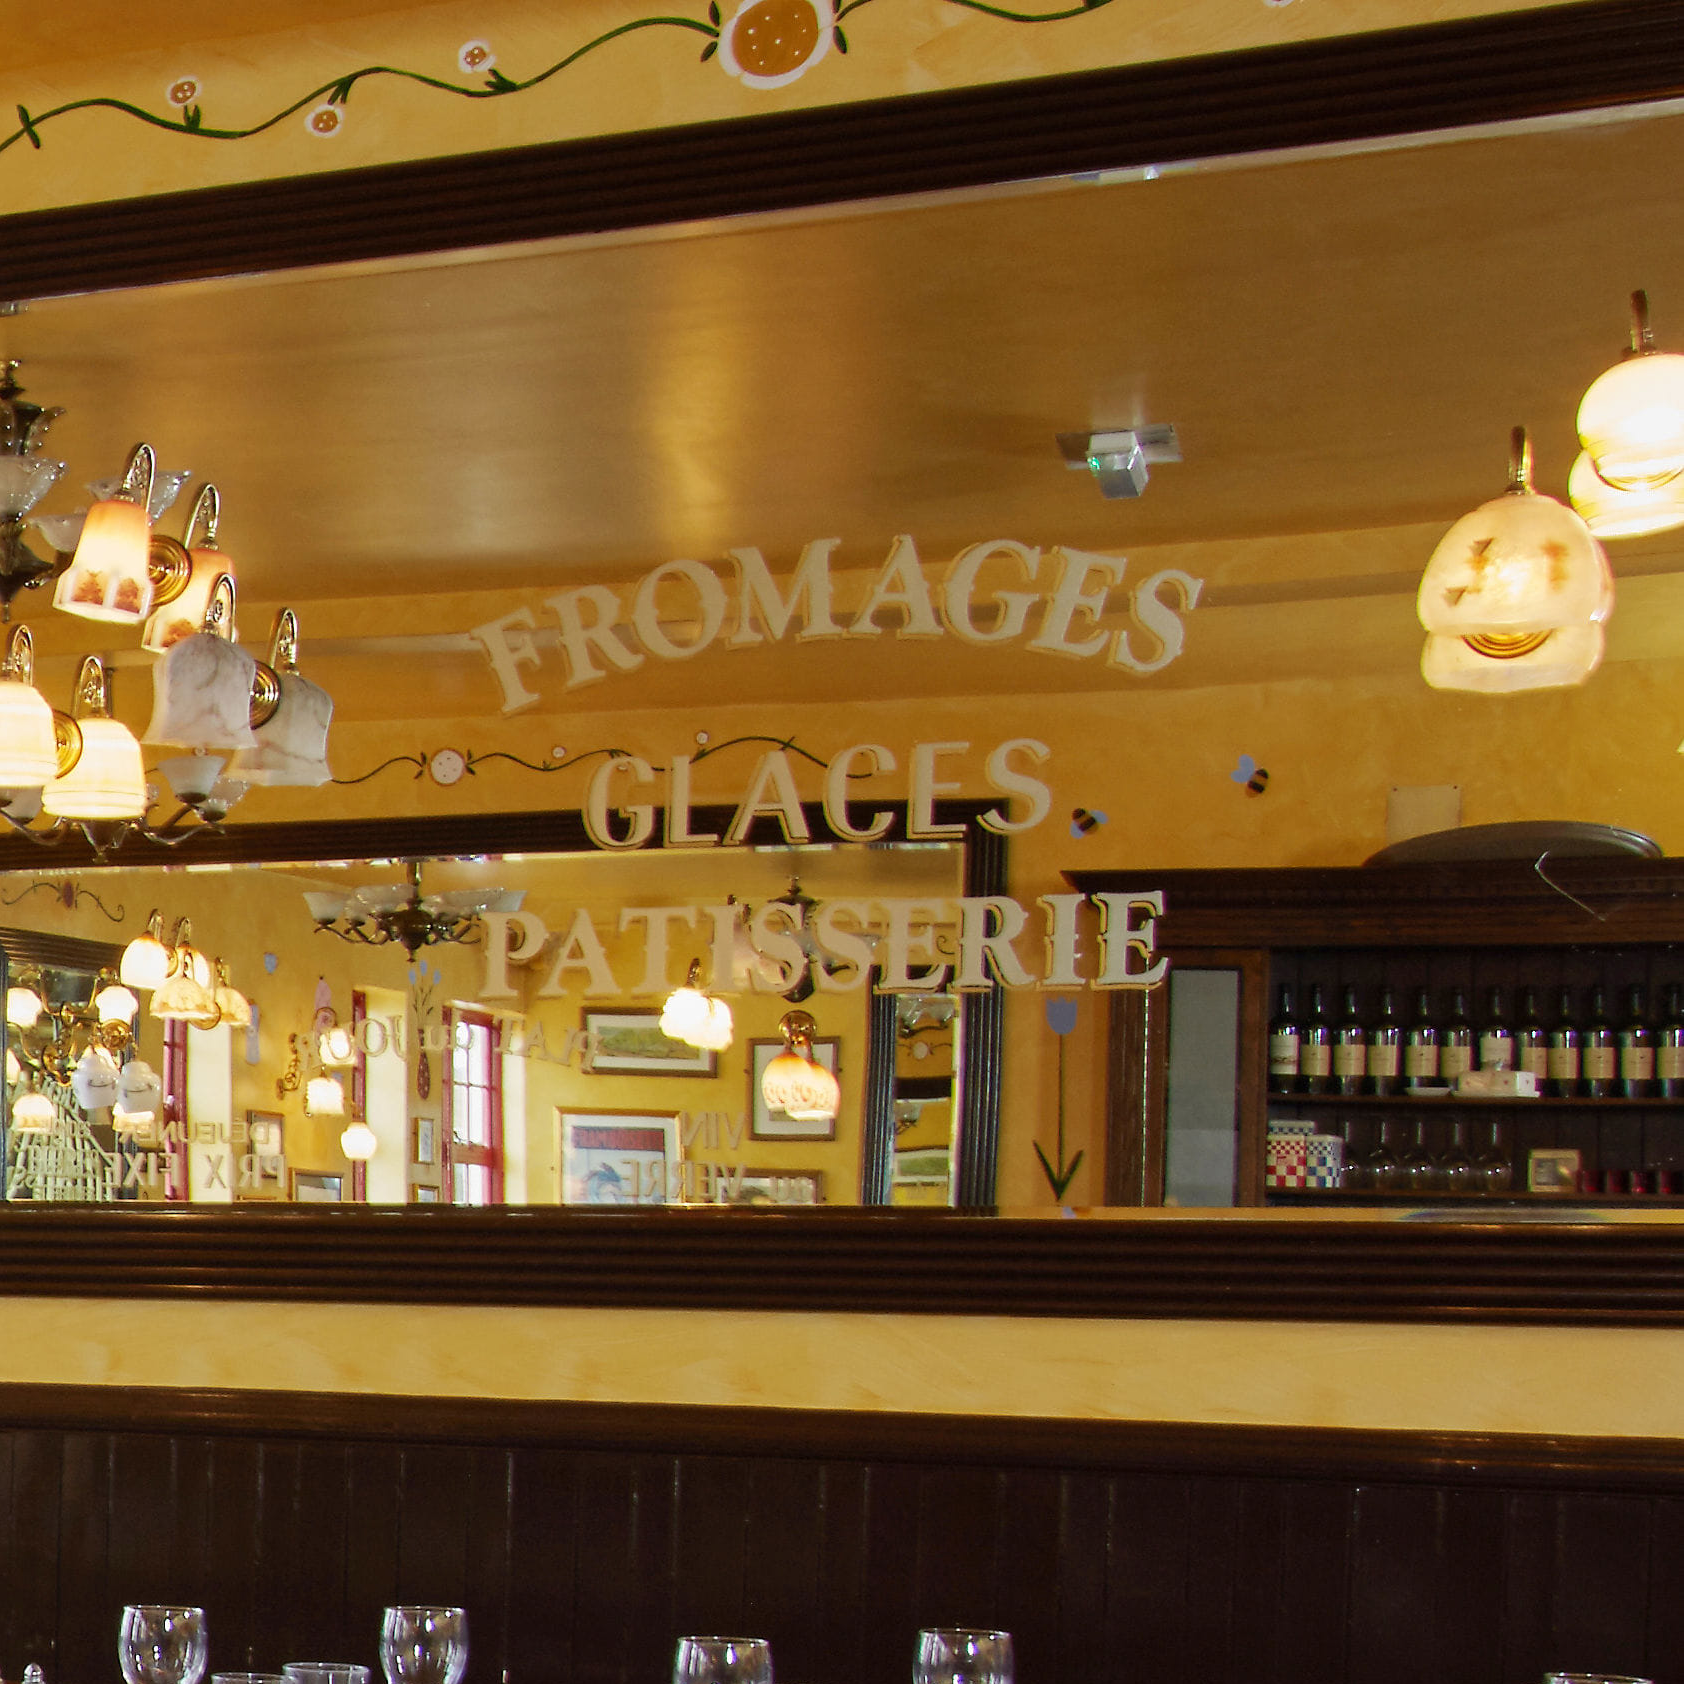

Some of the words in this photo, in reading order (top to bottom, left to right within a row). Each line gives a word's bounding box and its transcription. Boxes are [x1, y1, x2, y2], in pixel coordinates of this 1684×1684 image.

[471, 534, 1204, 716] FROMAGES
[581, 737, 1053, 851] GLACES
[475, 889, 1169, 1000] PATISSERIE
